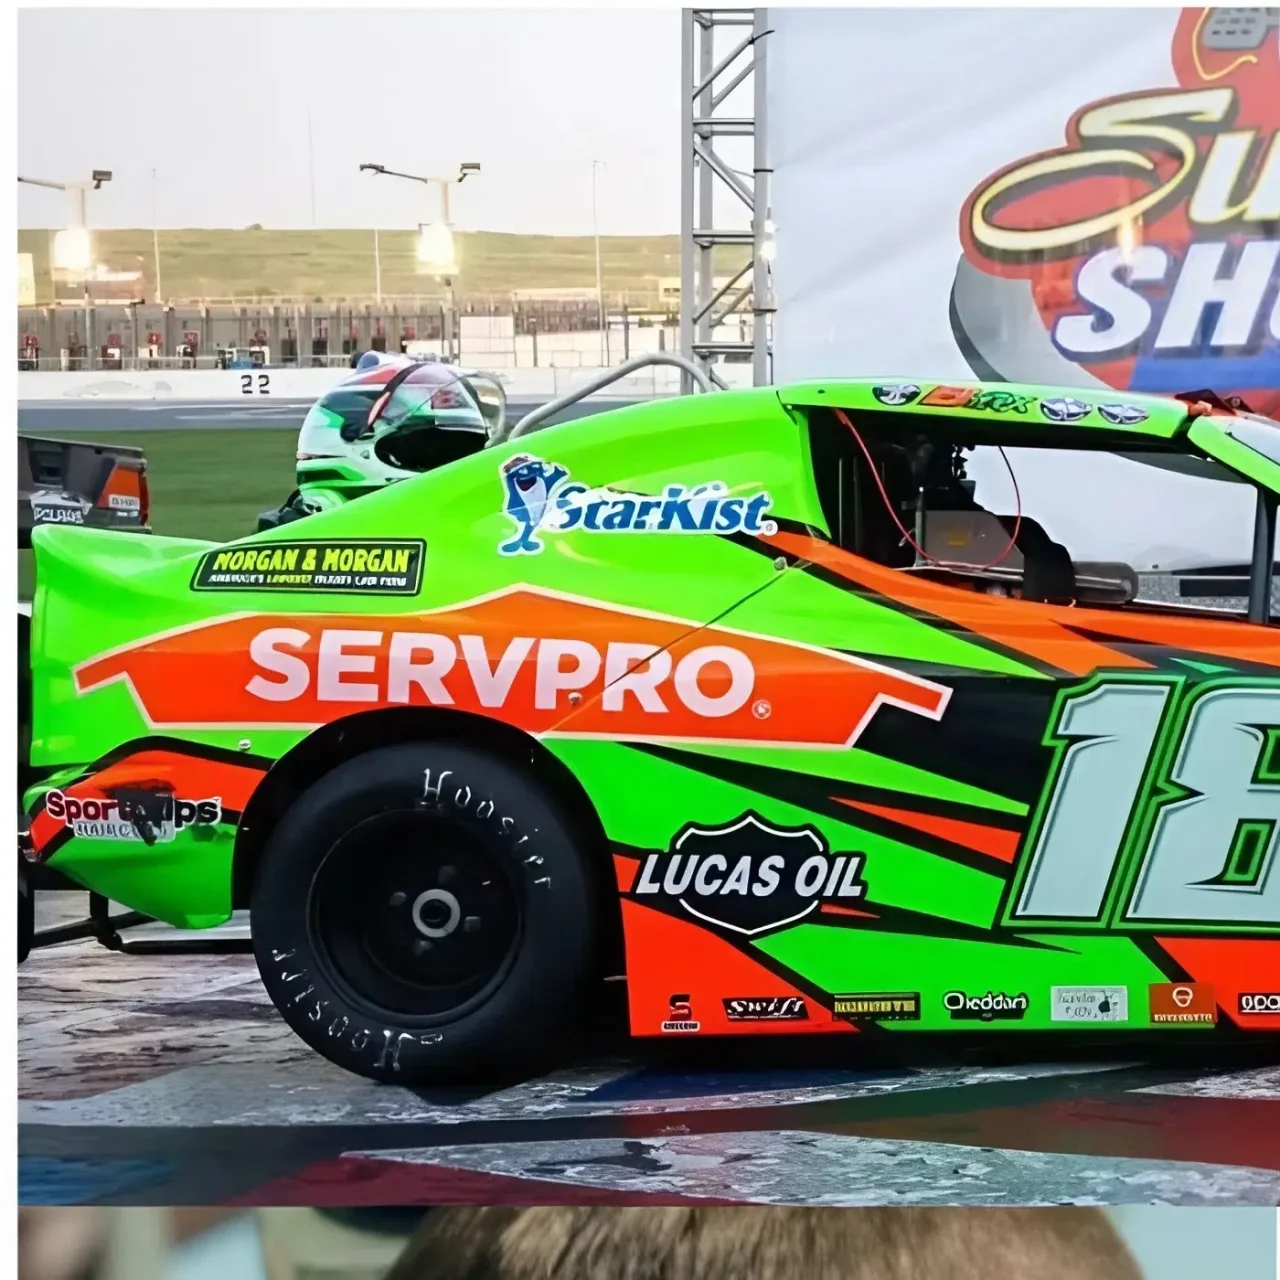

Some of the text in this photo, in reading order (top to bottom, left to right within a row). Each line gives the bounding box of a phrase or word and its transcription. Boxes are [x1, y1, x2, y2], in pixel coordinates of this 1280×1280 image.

[241, 374, 271, 395] 22
[555, 483, 772, 531] StarKist
[213, 548, 409, 573] MORGAN & MORGAN
[245, 627, 756, 718] SERVPRO
[635, 854, 863, 897] LUCAS OIL
